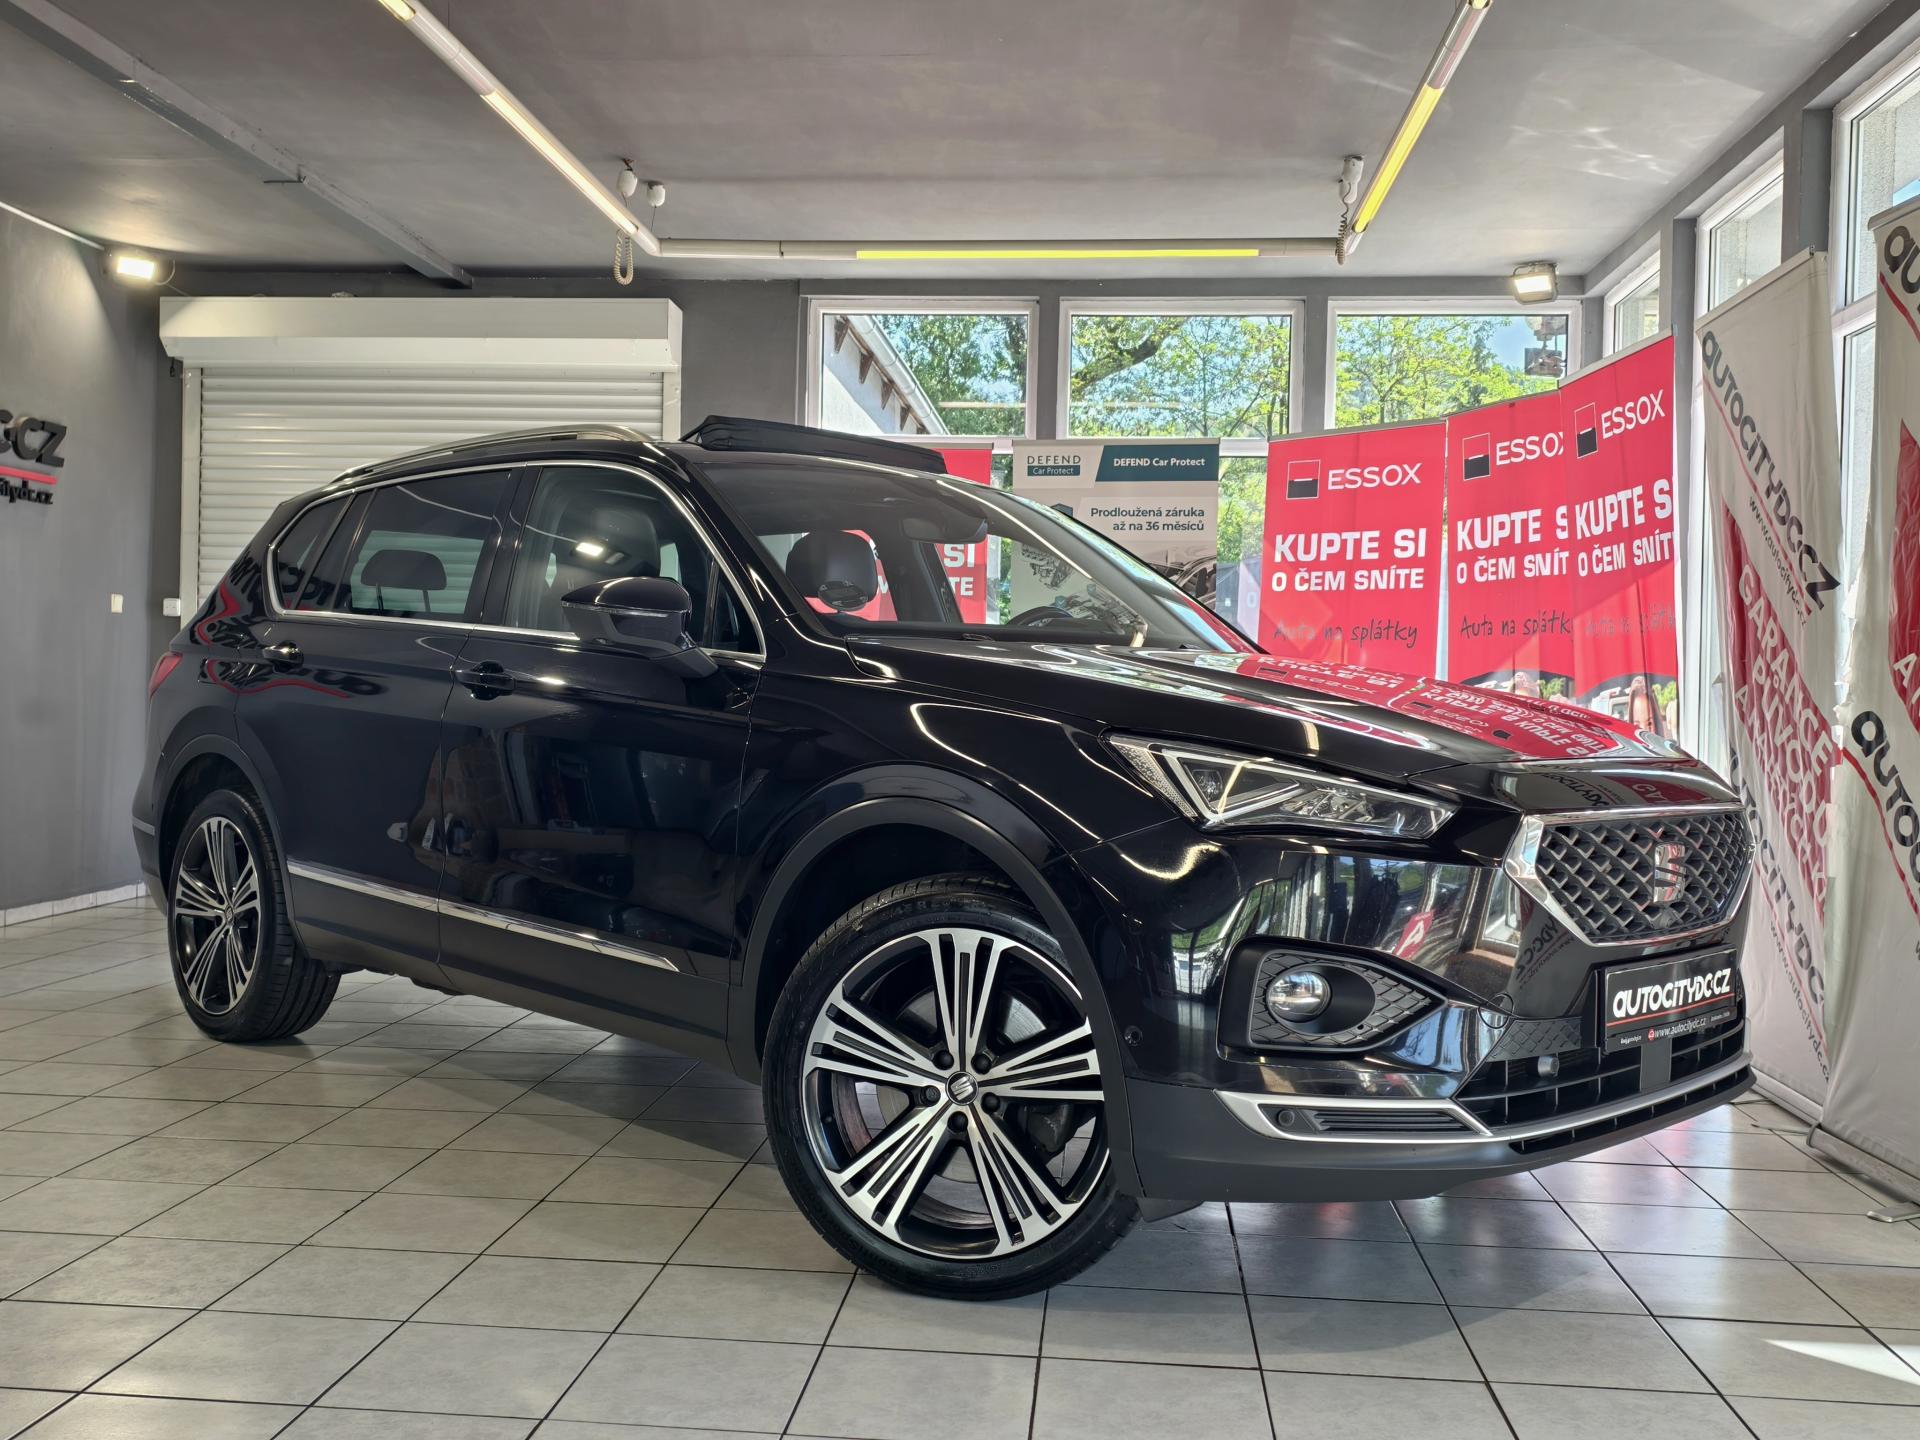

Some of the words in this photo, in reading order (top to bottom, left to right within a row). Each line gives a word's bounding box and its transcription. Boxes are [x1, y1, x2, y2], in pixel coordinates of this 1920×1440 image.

[1601, 389, 1666, 440] ESSOX
[1027, 455, 1081, 465] DEFEND
[1033, 467, 1046, 475] Car
[1047, 467, 1074, 475] Protect
[1113, 458, 1150, 467] DEFEND
[1152, 458, 1169, 467] Car
[1170, 458, 1205, 467] Protect
[1328, 463, 1423, 490] ESSOX
[1091, 507, 1162, 517] Prodloužená
[1165, 507, 1205, 517] záruka
[1575, 485, 1645, 540] KUPTE
[1653, 479, 1674, 519] S
[1113, 521, 1127, 531] až
[1129, 523, 1143, 531] na
[1145, 522, 1159, 531] 36
[1162, 521, 1205, 531] měsíců
[1457, 508, 1542, 552] KUPTE
[1556, 505, 1569, 540] S
[943, 543, 976, 568] SI
[1274, 530, 1380, 563] KUPTE
[1393, 528, 1427, 559] SI
[1578, 552, 1588, 577] O
[1592, 542, 1627, 575] ČEM
[1632, 529, 1675, 567] SNÍT
[1271, 572, 1287, 592] O
[1294, 567, 1346, 592] ČEM
[1354, 565, 1424, 591] SNÍTE
[1457, 562, 1468, 584] O
[1474, 555, 1516, 582] ČEM
[1523, 547, 1570, 578] SNÍT
[1351, 619, 1418, 648] splátky
[1461, 615, 1494, 639] Auta
[1501, 617, 1516, 635] na
